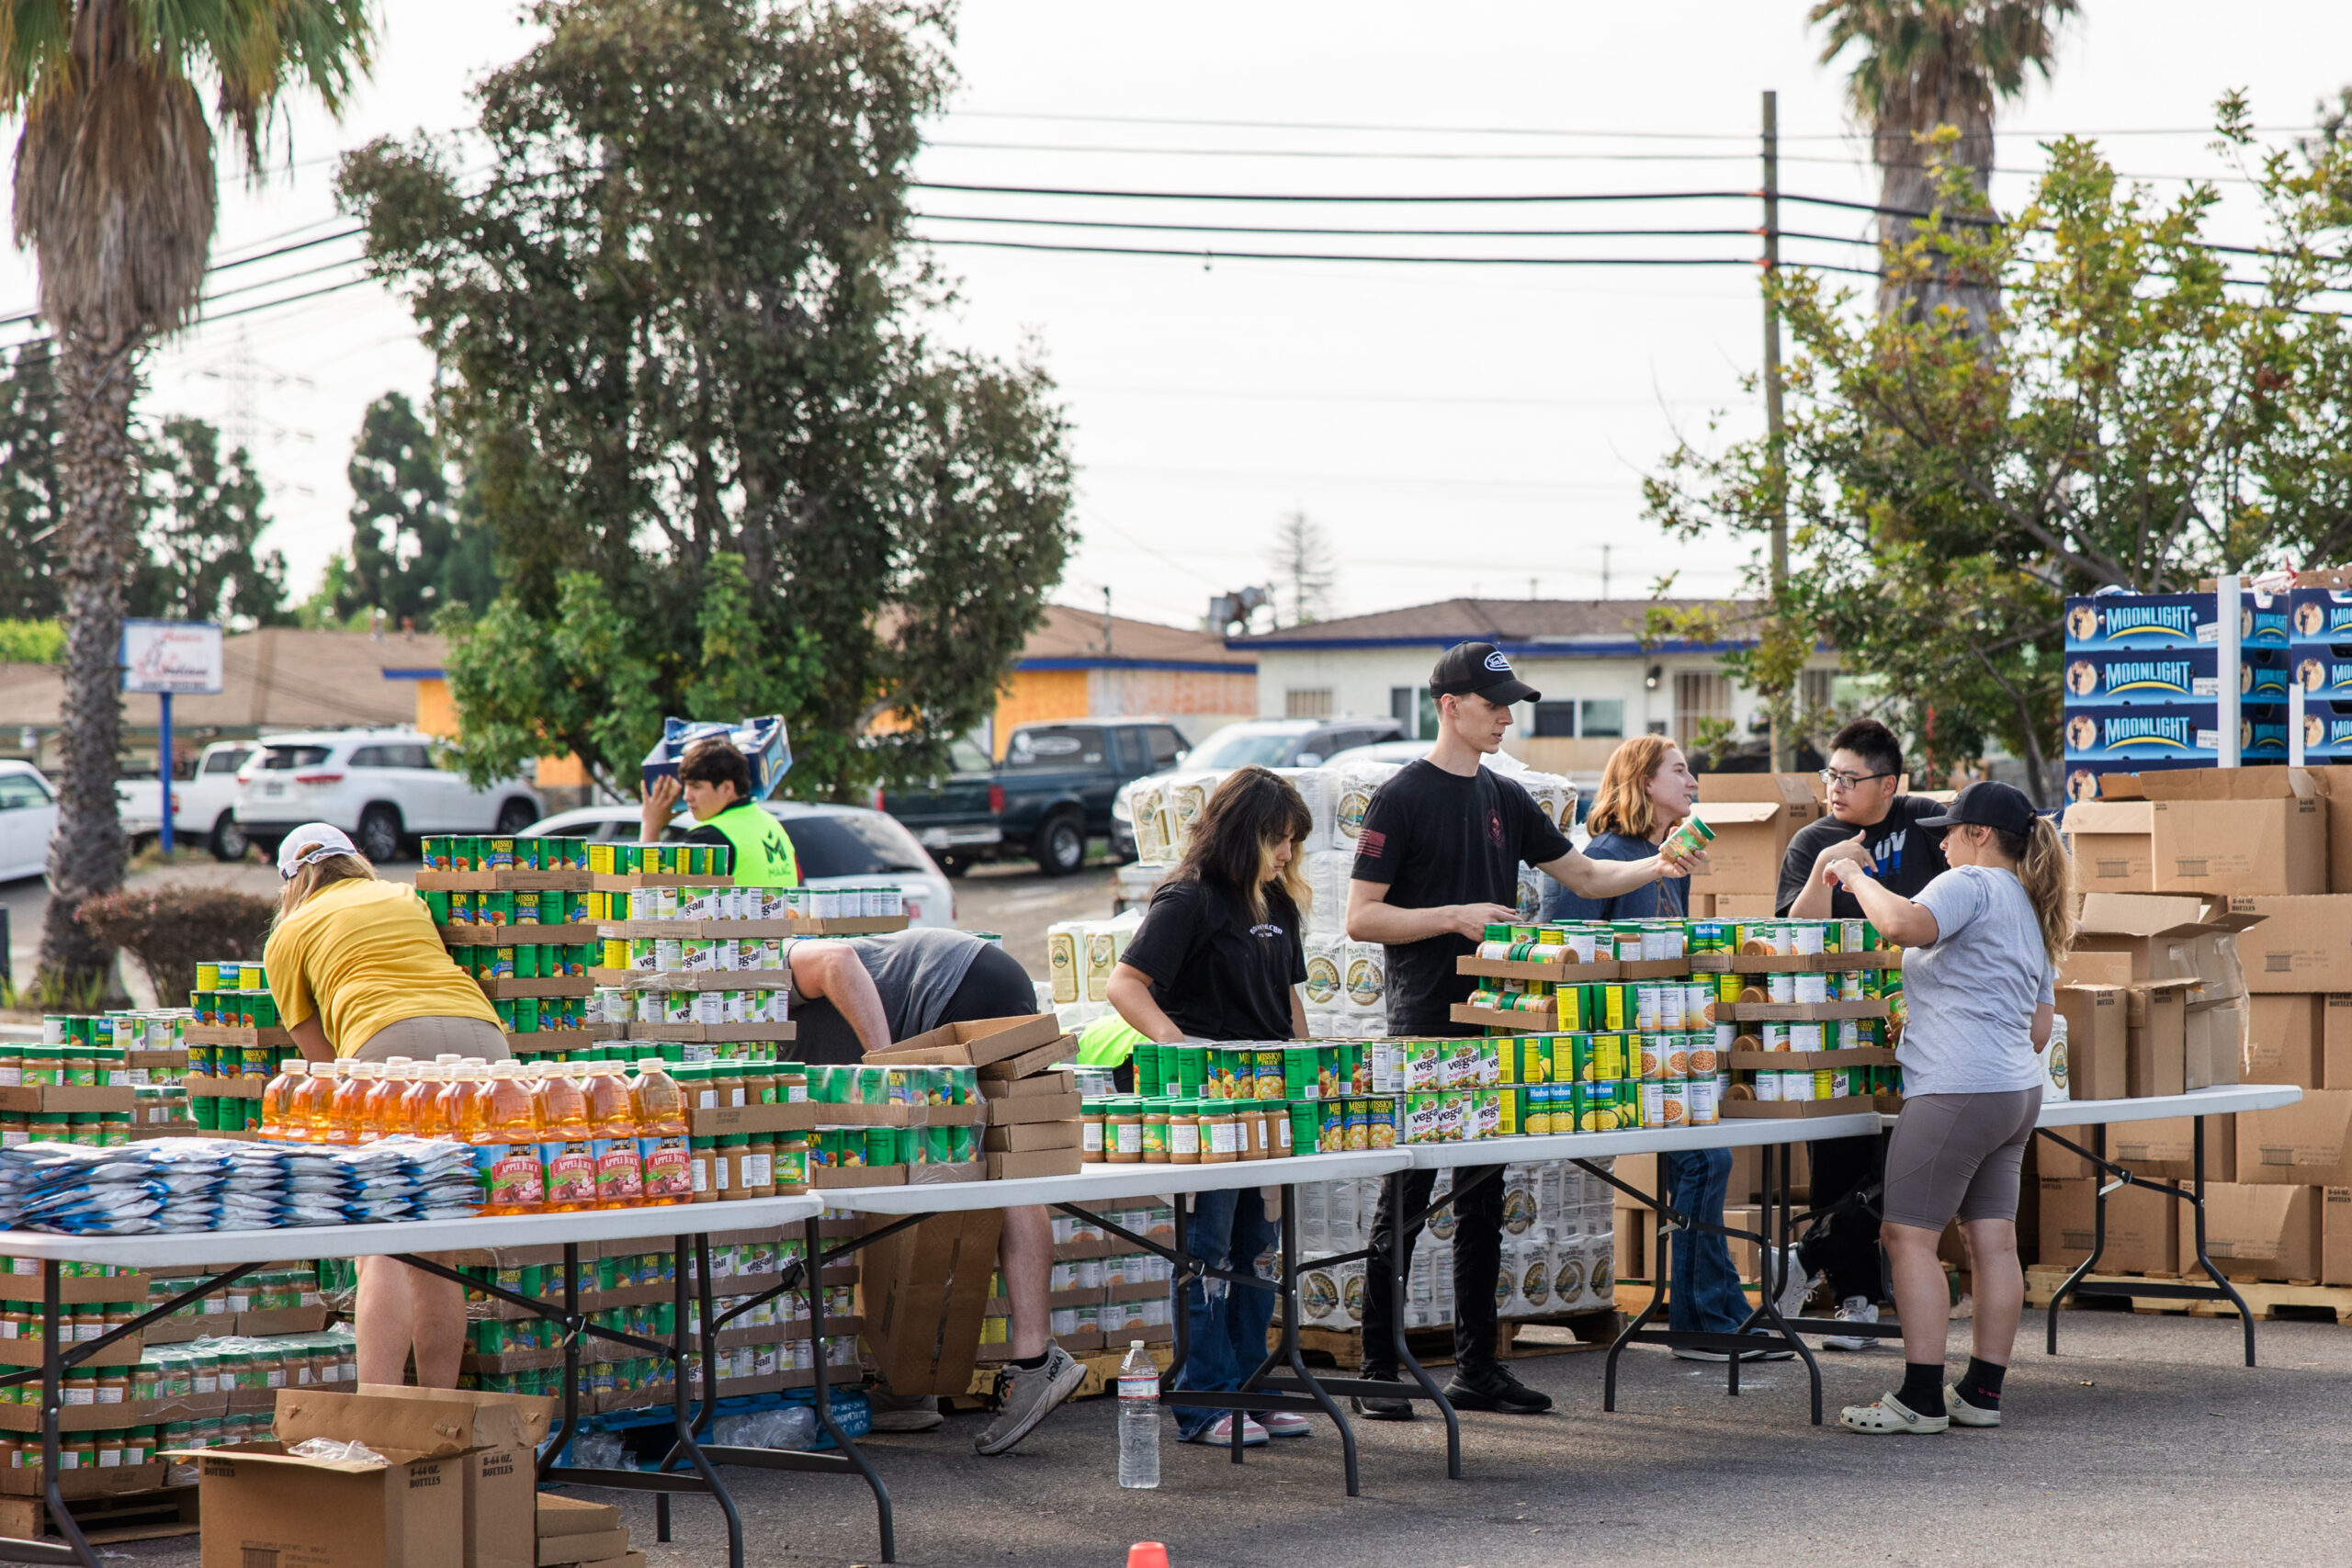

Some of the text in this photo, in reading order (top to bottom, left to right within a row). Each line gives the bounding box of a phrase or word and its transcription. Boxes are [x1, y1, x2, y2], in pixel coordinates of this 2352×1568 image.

[2106, 606, 2191, 635] MOONLIGHT
[2256, 614, 2288, 636] MOONLIGHT
[2105, 662, 2190, 691] MOONLIGHT
[2256, 669, 2288, 691] MOONLIGHT
[2105, 717, 2189, 746] MOONLIGHT
[514, 894, 538, 905] MISSION
[243, 1049, 267, 1059] MISSION
[1256, 1052, 1283, 1062] MISSION
[1413, 1071, 1433, 1081] Original
[1349, 1101, 1367, 1111] MISSIO
[1368, 1100, 1393, 1110] MISSION
[1412, 1122, 1433, 1133] Original
[566, 1143, 584, 1152] LANGERS
[612, 1139, 630, 1148] LANGERS
[662, 1138, 679, 1147] LANGERS
[511, 1145, 530, 1154] LANGERS
[559, 1158, 592, 1170] APPLE JUICE
[605, 1155, 638, 1167] APPLE JUICE
[654, 1153, 685, 1166] APPLE JUICE
[502, 1160, 538, 1173] APPLE JUICE
[1046, 1355, 1064, 1382] HOKA
[483, 1454, 513, 1466] 8-64 OZ.
[204, 1467, 235, 1477] BOTTLES
[410, 1467, 427, 1477] 8-64
[482, 1465, 514, 1478] BOTTLES
[410, 1476, 441, 1488] BOTTLES
